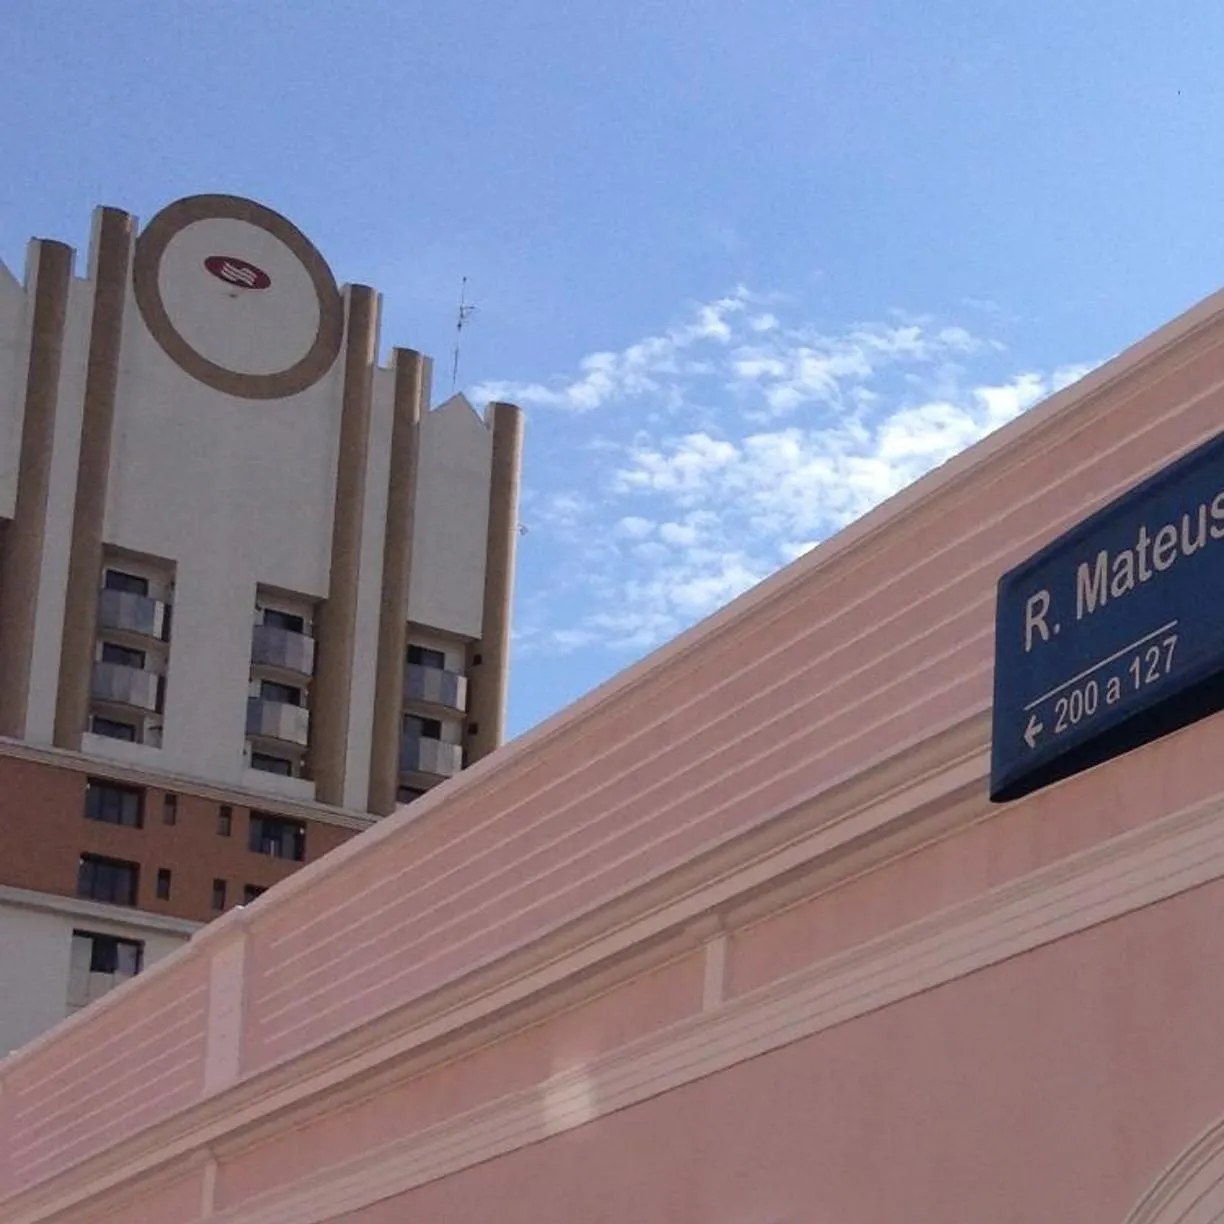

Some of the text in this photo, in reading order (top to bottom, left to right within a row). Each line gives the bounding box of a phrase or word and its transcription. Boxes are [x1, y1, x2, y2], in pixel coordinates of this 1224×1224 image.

[1025, 589, 1060, 652] R.
[1054, 635, 1178, 734] 200 a 127
